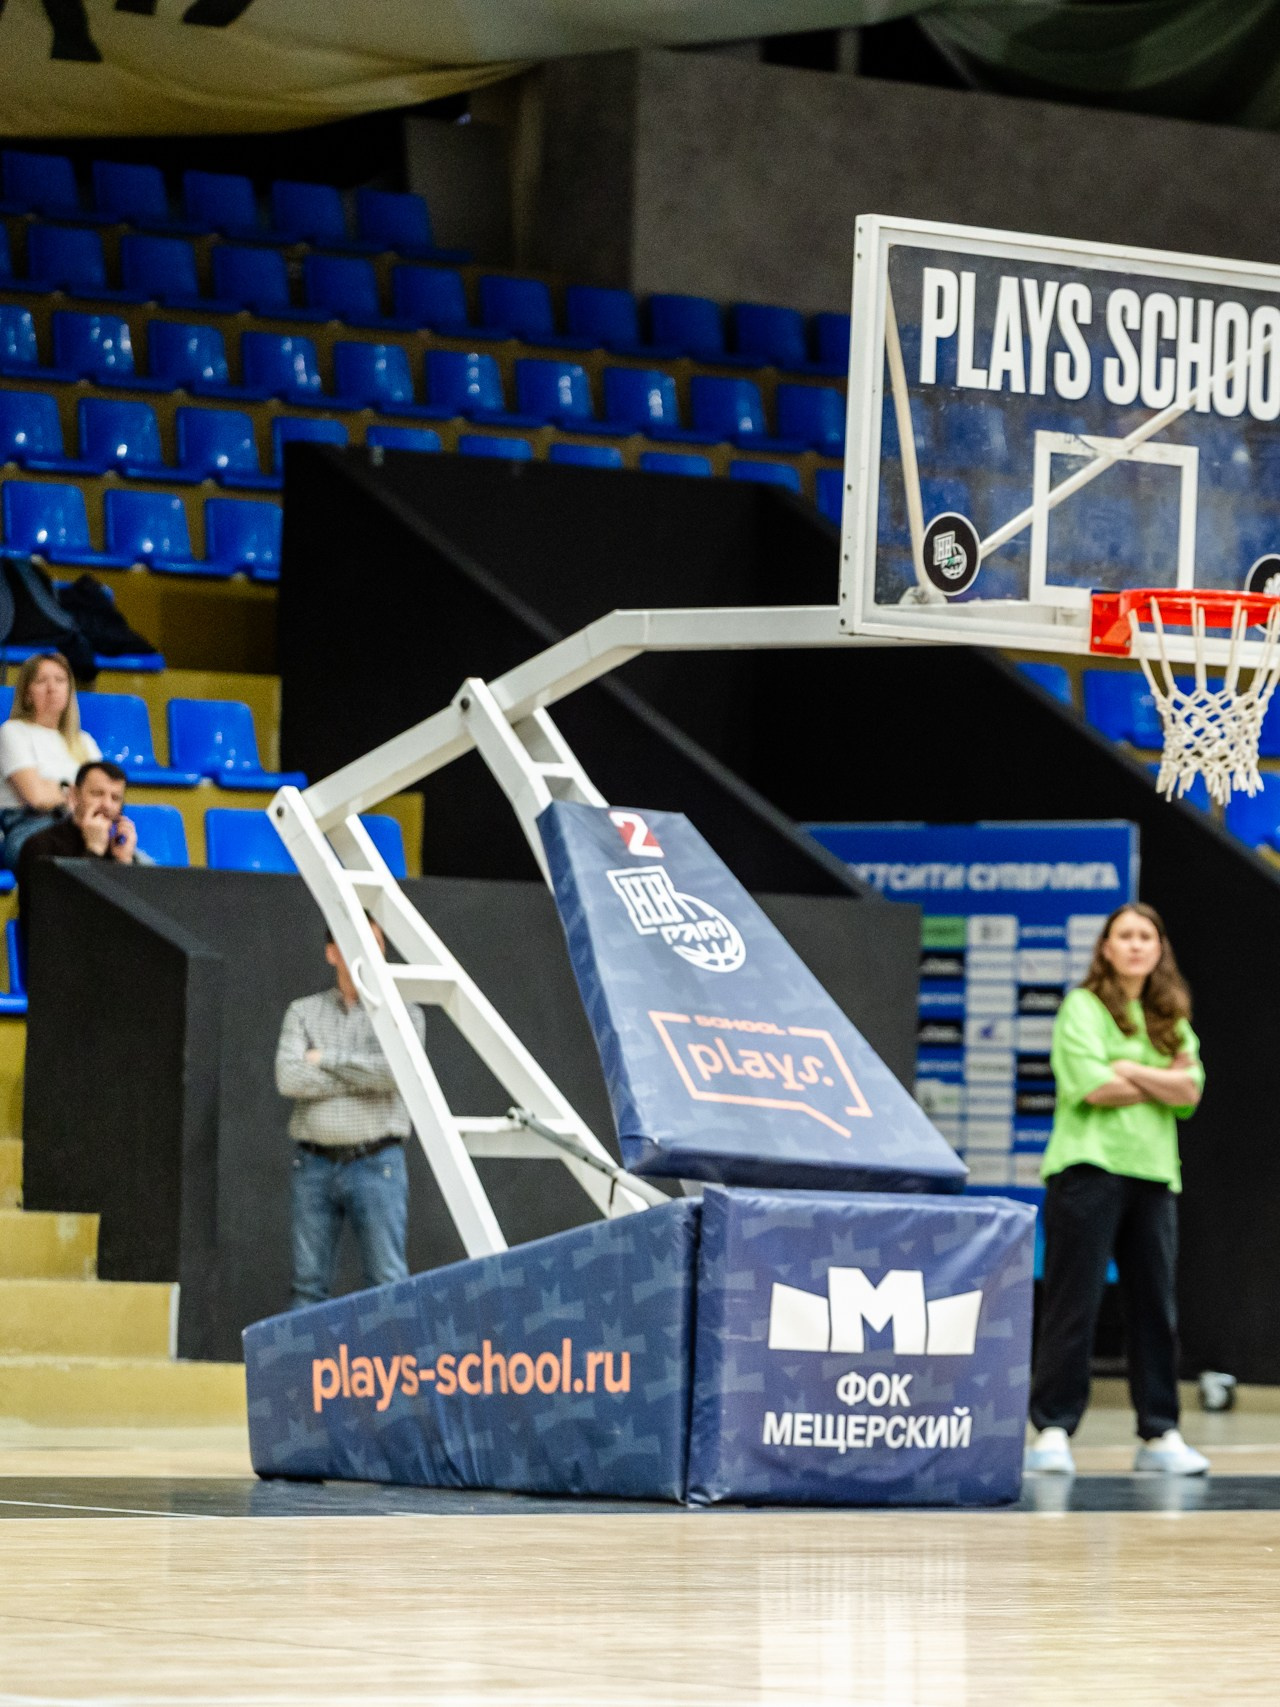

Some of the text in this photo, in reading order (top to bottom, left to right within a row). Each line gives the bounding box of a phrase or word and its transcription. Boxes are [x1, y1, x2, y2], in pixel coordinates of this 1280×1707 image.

[919, 266, 1092, 400] PLAYS
[608, 811, 665, 858] 2
[660, 919, 728, 945] PARI
[694, 1014, 788, 1036] SCHOOL
[687, 1036, 835, 1091] plays.
[312, 1338, 631, 1413] plays-school.ru
[836, 1371, 914, 1408] ФОК
[762, 1406, 972, 1454] МЕЩЕРСКИЙ
